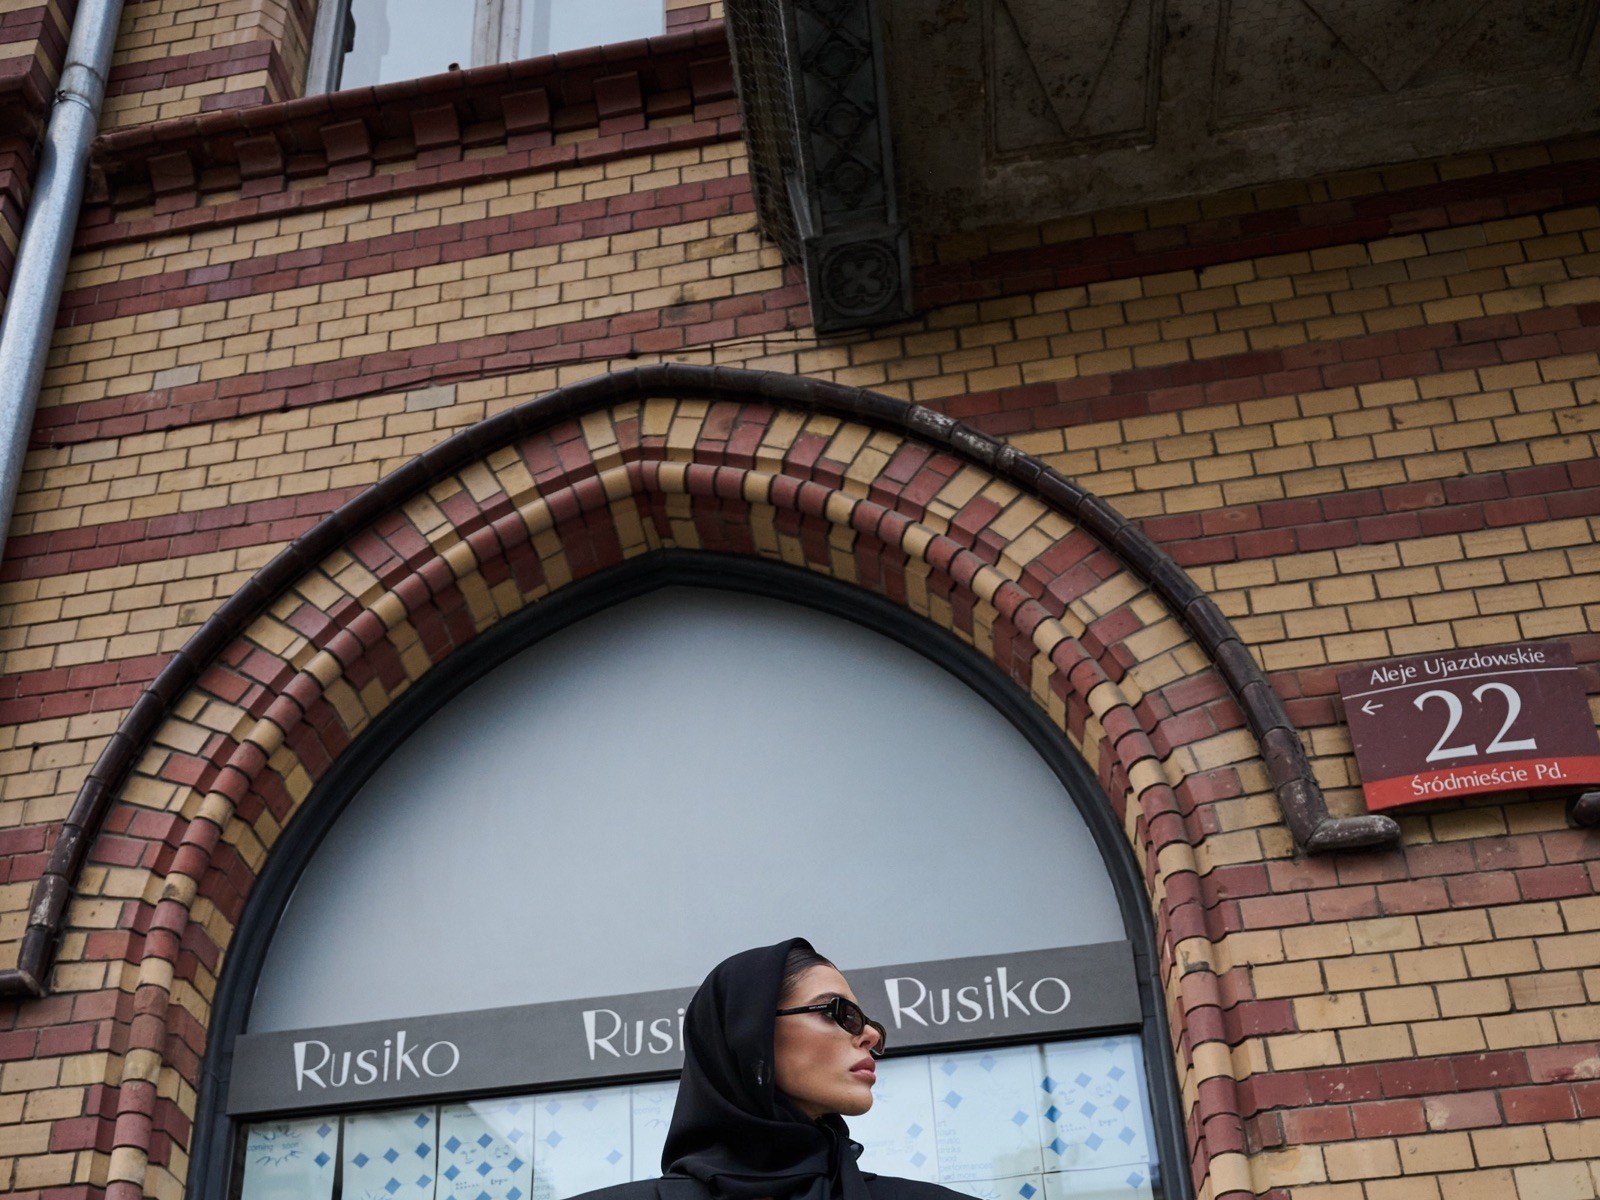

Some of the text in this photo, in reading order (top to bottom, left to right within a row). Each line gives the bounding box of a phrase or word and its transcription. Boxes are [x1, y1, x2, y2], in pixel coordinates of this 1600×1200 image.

[1370, 648, 1546, 685] Aleje Ujazdowskie
[1413, 682, 1537, 763] 22
[1411, 762, 1567, 796] Śródmieście Pd.
[884, 967, 1071, 1029] Rusiko
[293, 1031, 460, 1091] Rusiko
